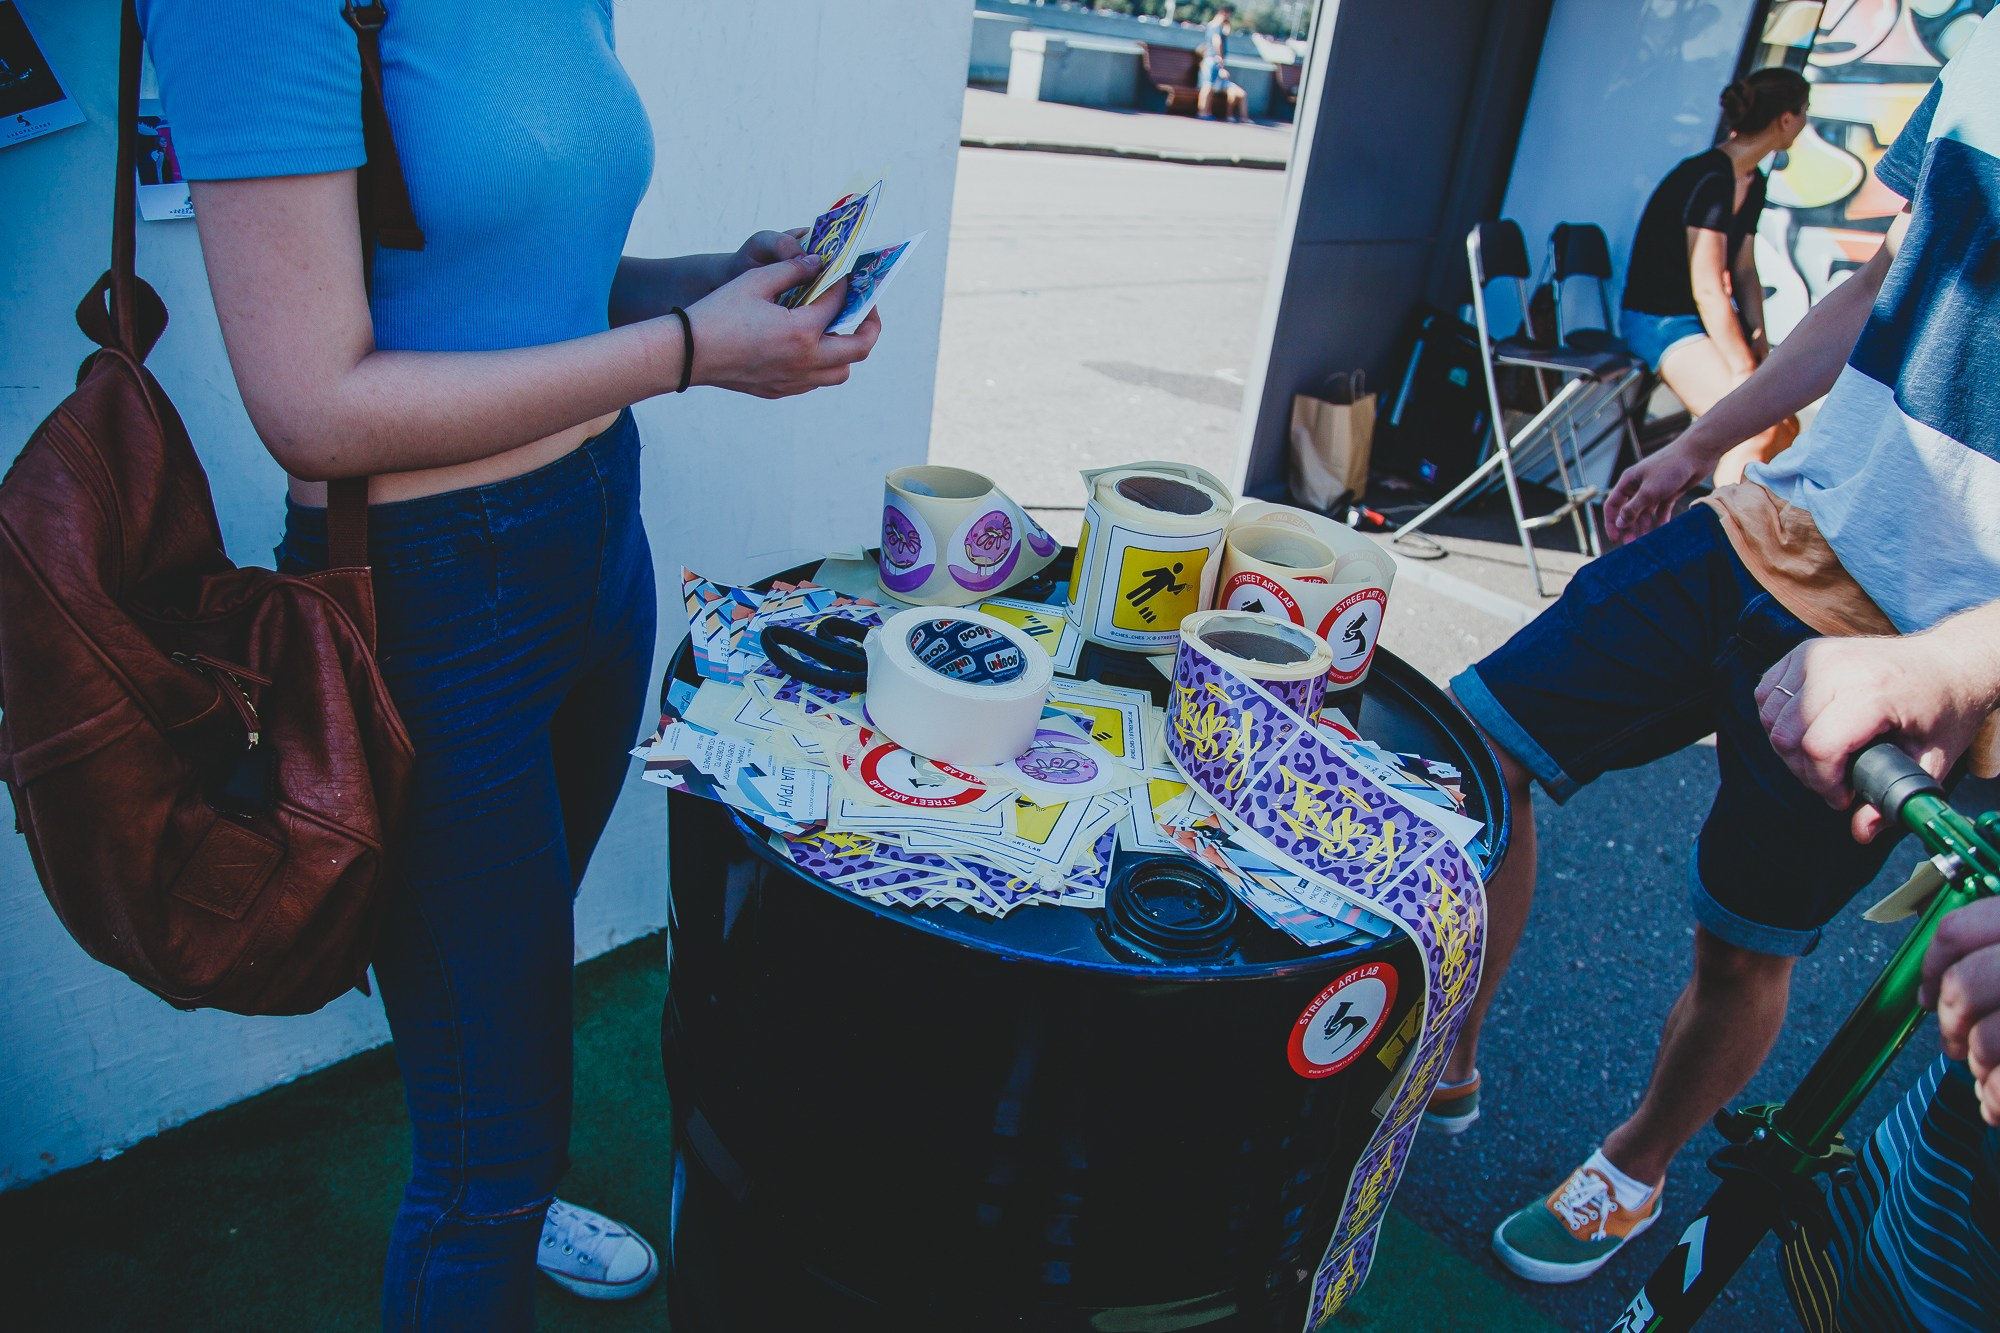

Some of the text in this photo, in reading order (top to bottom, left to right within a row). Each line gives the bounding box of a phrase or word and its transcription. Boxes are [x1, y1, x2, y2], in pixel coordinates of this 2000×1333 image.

[1234, 574, 1294, 609] STREET ART LAB
[1336, 592, 1366, 614] STREET
[1366, 591, 1379, 599] ART
[943, 765, 965, 777] LAB
[777, 783, 794, 808] ТРУН
[869, 779, 957, 806] STREET ART LAB
[1300, 966, 1380, 1026] STREET ART LAB
